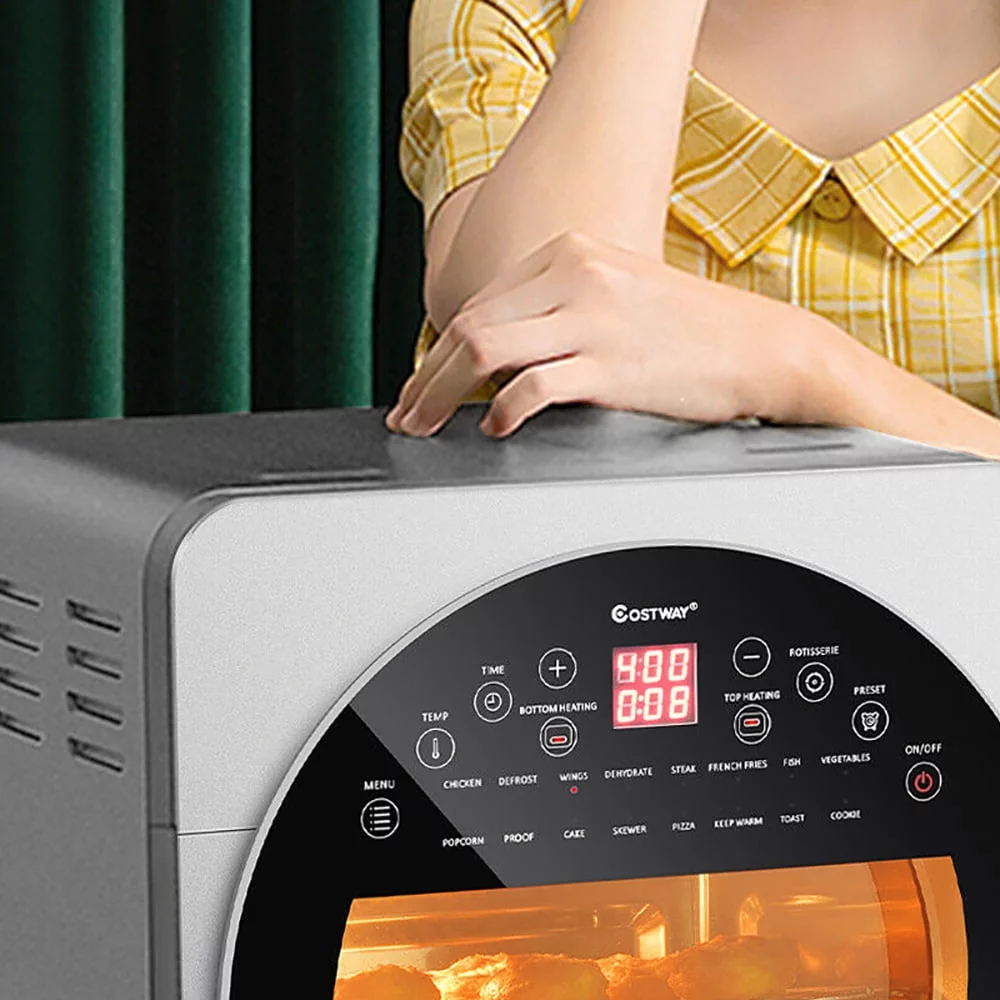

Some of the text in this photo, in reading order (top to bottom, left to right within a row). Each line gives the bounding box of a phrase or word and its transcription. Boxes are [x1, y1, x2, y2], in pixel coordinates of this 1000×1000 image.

[611, 604, 689, 624] COSTWAY
[482, 665, 504, 675] TIME
[854, 685, 885, 695] PRESET
[724, 690, 780, 702] TOP HEATING
[519, 702, 597, 715] BOTTOM HEATING
[422, 712, 448, 721] TEMP
[905, 743, 941, 755] ON/OFF
[783, 758, 800, 766] FISH
[821, 753, 870, 764] VEGETABLES
[671, 765, 696, 774] STEAK
[708, 760, 767, 771] FRENCH FRIES
[560, 772, 588, 781] WINGS
[605, 767, 652, 779] DEHYDRATE
[364, 780, 395, 790] MENU
[443, 779, 481, 789] CHICKEN
[499, 775, 537, 786] DEFROST
[780, 814, 804, 823] TOAST
[830, 810, 860, 820] COOKIE
[672, 822, 695, 830] PIZZA
[714, 817, 763, 828] KEEP WARM
[564, 830, 584, 839] CAKE
[613, 825, 646, 835] SKEWER
[442, 836, 484, 848] POPCORN
[504, 832, 534, 843] PROOF
